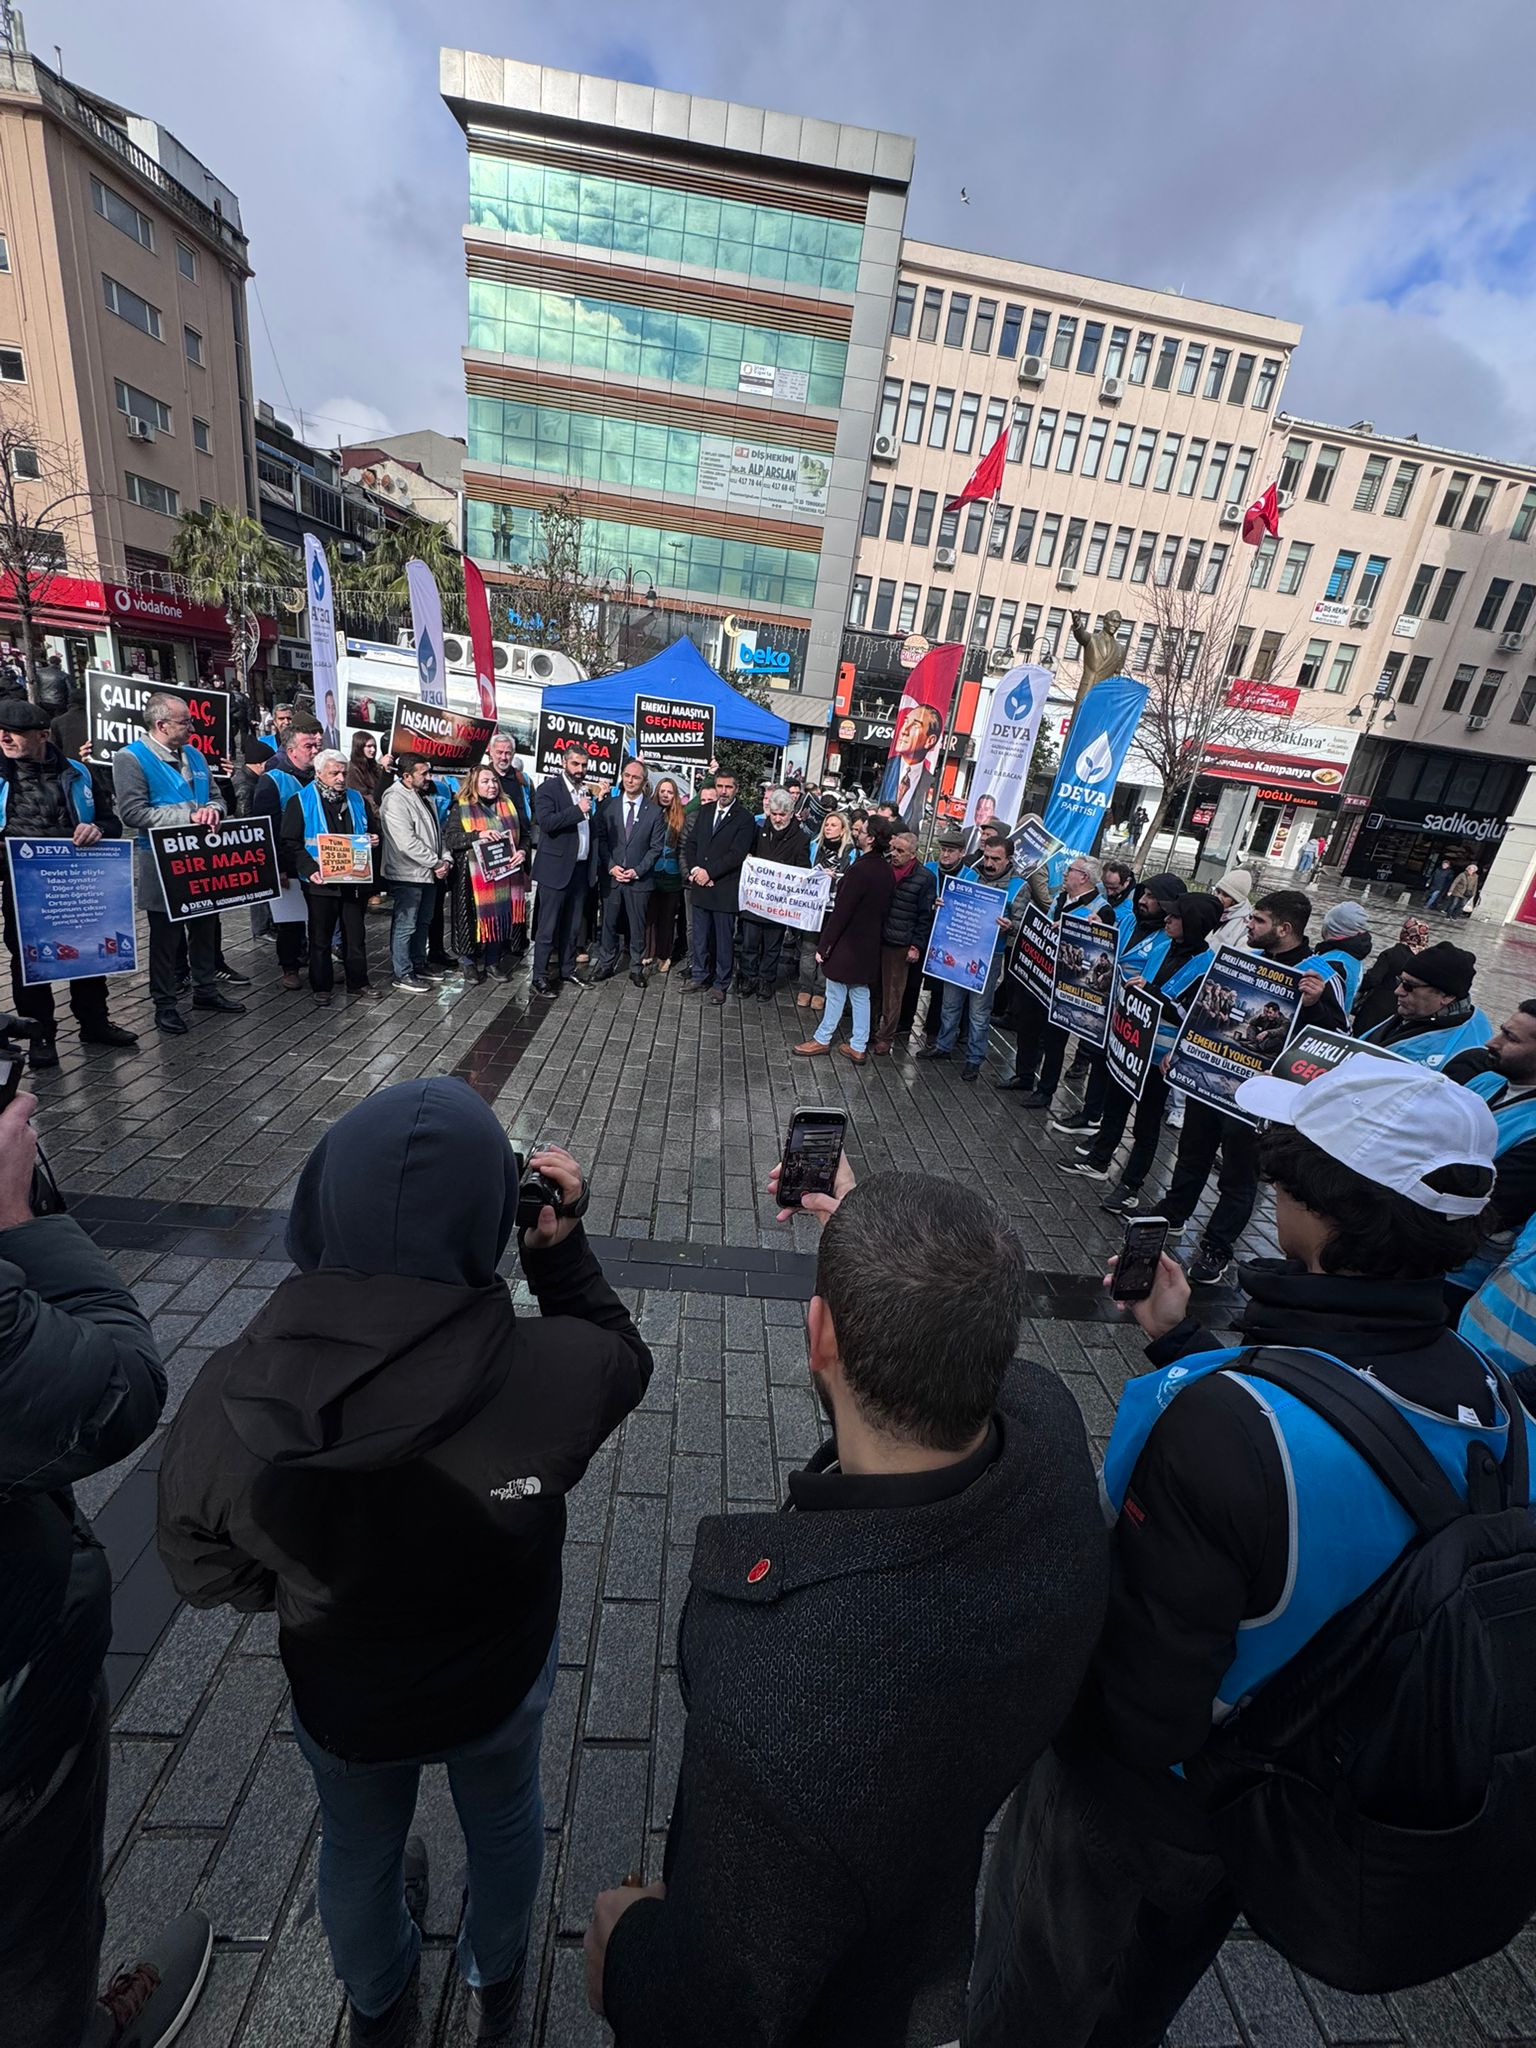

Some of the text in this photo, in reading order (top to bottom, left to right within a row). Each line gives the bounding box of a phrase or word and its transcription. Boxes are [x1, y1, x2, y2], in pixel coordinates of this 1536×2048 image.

[748, 463, 796, 480] ALP ARSLAN
[134, 600, 182, 618] vodafone
[740, 643, 790, 667] beko
[100, 684, 152, 712] ÇALIŞ
[641, 701, 671, 714] EMEKLİ
[400, 704, 452, 736] İNSANCA
[547, 715, 620, 746] 30 YIL ÇALIŞ,
[645, 716, 705, 731] GEÇİNMEK
[640, 730, 704, 744] İMKANSIZ
[991, 723, 1030, 741] DEVA
[189, 734, 220, 755] OK.
[1255, 761, 1311, 778] Kampanya
[1058, 782, 1106, 808] DEVA
[1060, 802, 1096, 816] PARTİSİ
[1422, 812, 1506, 841] sadıkoğlu
[36, 846, 70, 854] DEVA
[163, 826, 266, 854] BİR ÖMÜR
[171, 848, 266, 875] BİR MAAŞ
[756, 866, 774, 876] GÜN
[189, 866, 259, 895] ETMEDİ
[760, 880, 776, 889] GEÇ
[777, 884, 818, 898] BAŞLAYANA
[956, 884, 972, 893] DEVA
[190, 900, 214, 910] DEVA
[1032, 916, 1044, 931] BU
[1022, 925, 1047, 951] EMEKLİ
[1020, 938, 1054, 975] YOKSULLU
[1018, 952, 1054, 988] TERFİ ETMEK
[1220, 952, 1240, 965] EMEKLİ
[1256, 965, 1286, 983] 20.000
[1286, 976, 1294, 986] TL
[1058, 980, 1062, 988] 5
[1255, 978, 1286, 996] 100.000
[1286, 990, 1295, 1000] TL
[1126, 994, 1152, 1028] ÇALIŞ,
[1186, 1030, 1264, 1071] 5 EMEKLİ 1 YOKSUL
[1298, 1036, 1349, 1062] EMEKLİ
[1126, 1052, 1144, 1077] OL!
[1186, 1044, 1256, 1078] EDİYOR BU ÜLKEDE!
[1176, 1072, 1197, 1088] DEVA
